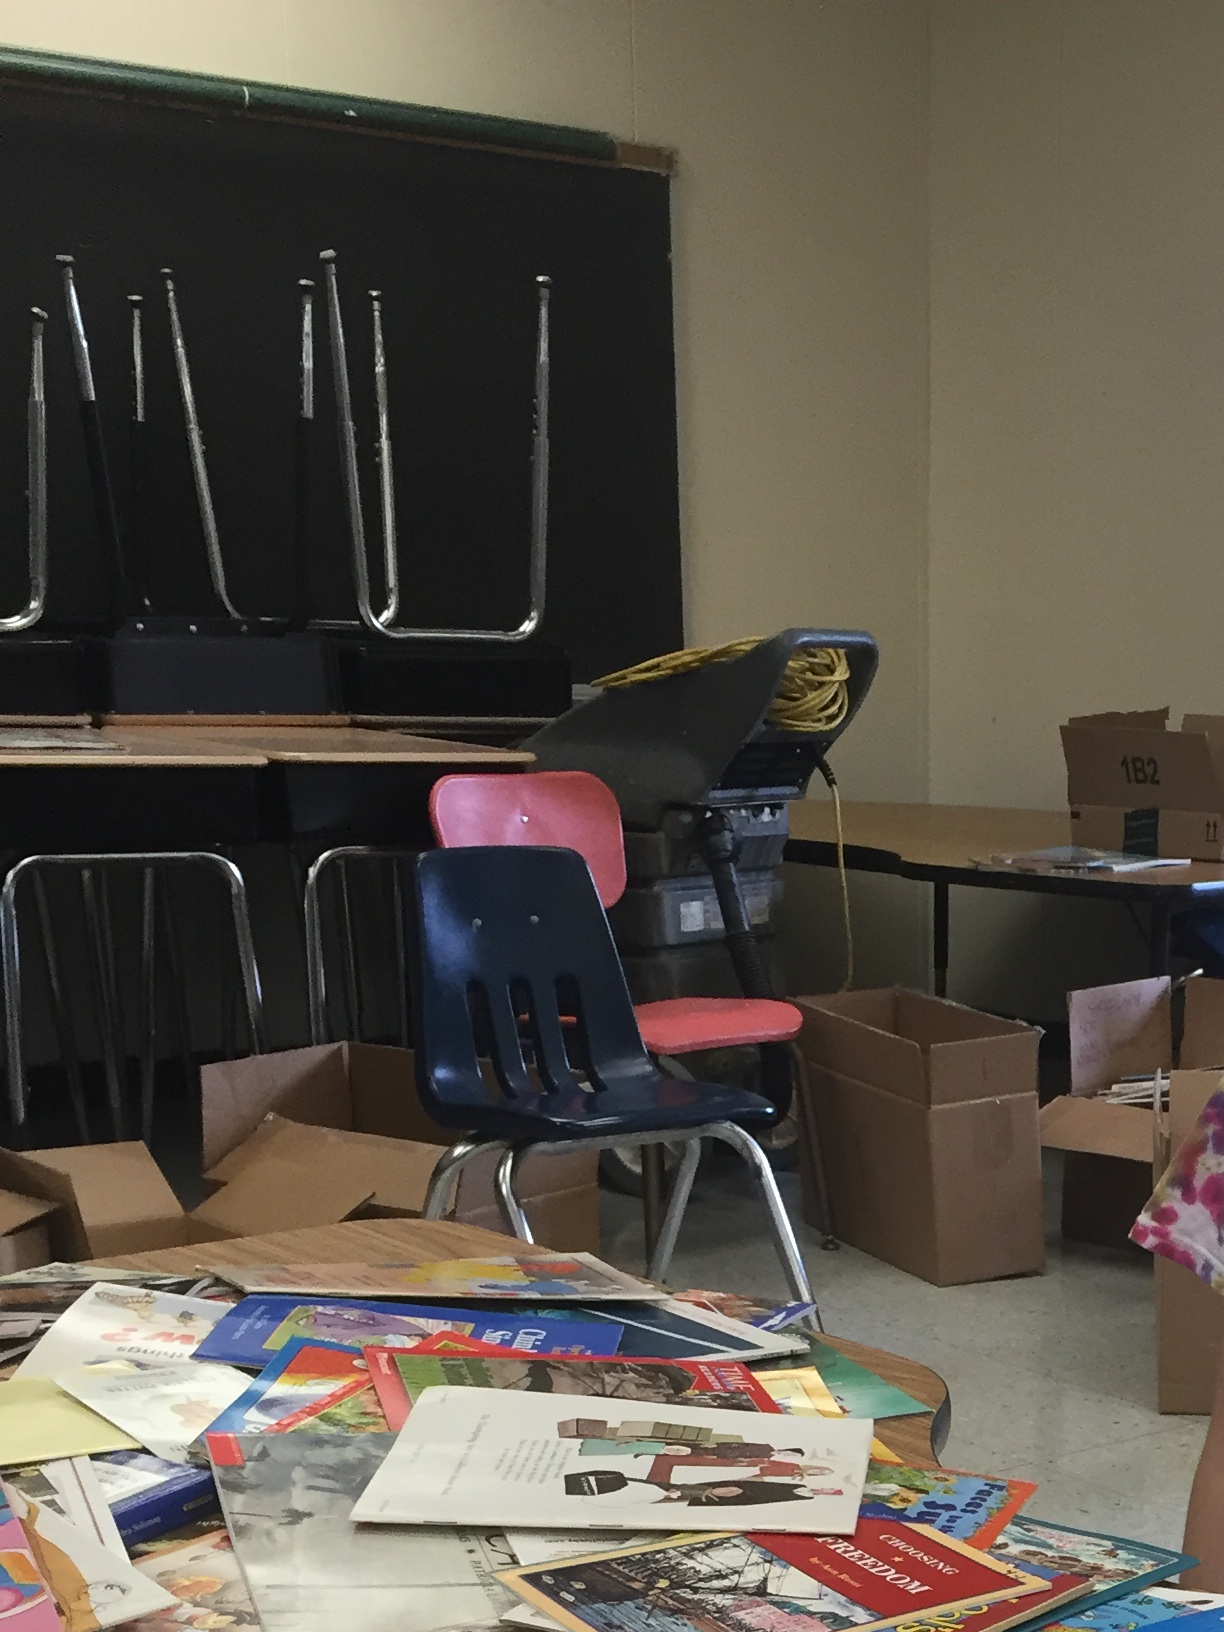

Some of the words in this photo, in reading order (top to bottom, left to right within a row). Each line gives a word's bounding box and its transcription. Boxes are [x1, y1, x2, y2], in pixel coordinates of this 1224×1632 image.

[1120, 755, 1161, 786] 1B2
[814, 1534, 934, 1595] FREEDOM
[879, 1533, 960, 1576] CHOOSING
